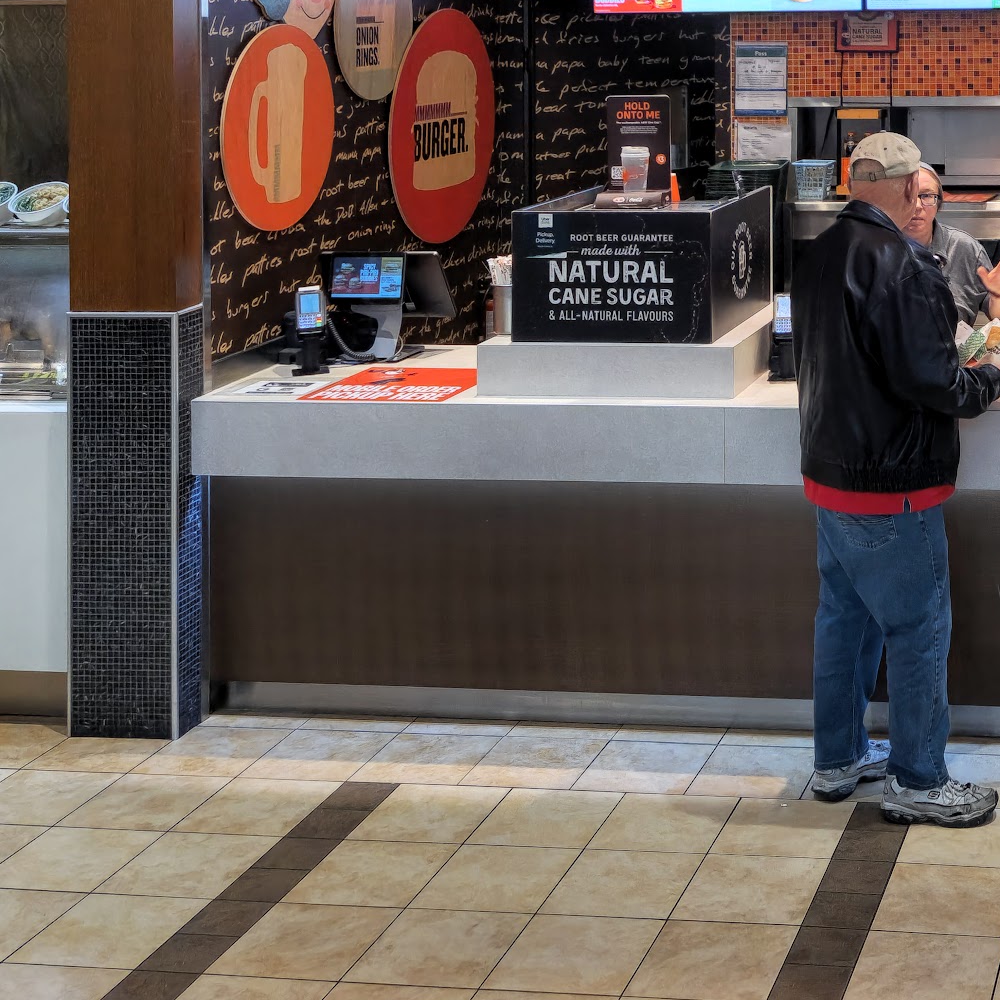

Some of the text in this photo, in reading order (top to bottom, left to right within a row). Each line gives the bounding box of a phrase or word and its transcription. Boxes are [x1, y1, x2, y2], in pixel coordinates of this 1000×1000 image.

[356, 27, 379, 46] ONION
[624, 101, 650, 110] HOLD
[616, 111, 661, 119] ONTO ME
[413, 117, 468, 162] BURGER.
[570, 234, 674, 242] ROOT BEER GUARANTEE
[581, 244, 641, 256] made with
[242, 252, 282, 288] patties
[549, 260, 674, 284] NATURAL
[549, 287, 674, 306] CANE SUGAR
[226, 291, 268, 319] burgers
[549, 310, 674, 322] & ALL-NATURAL FLAVOURS
[243, 321, 282, 350] patties
[308, 391, 447, 401] PICKUP HERE
[329, 384, 463, 394] MOBILE ORDER
